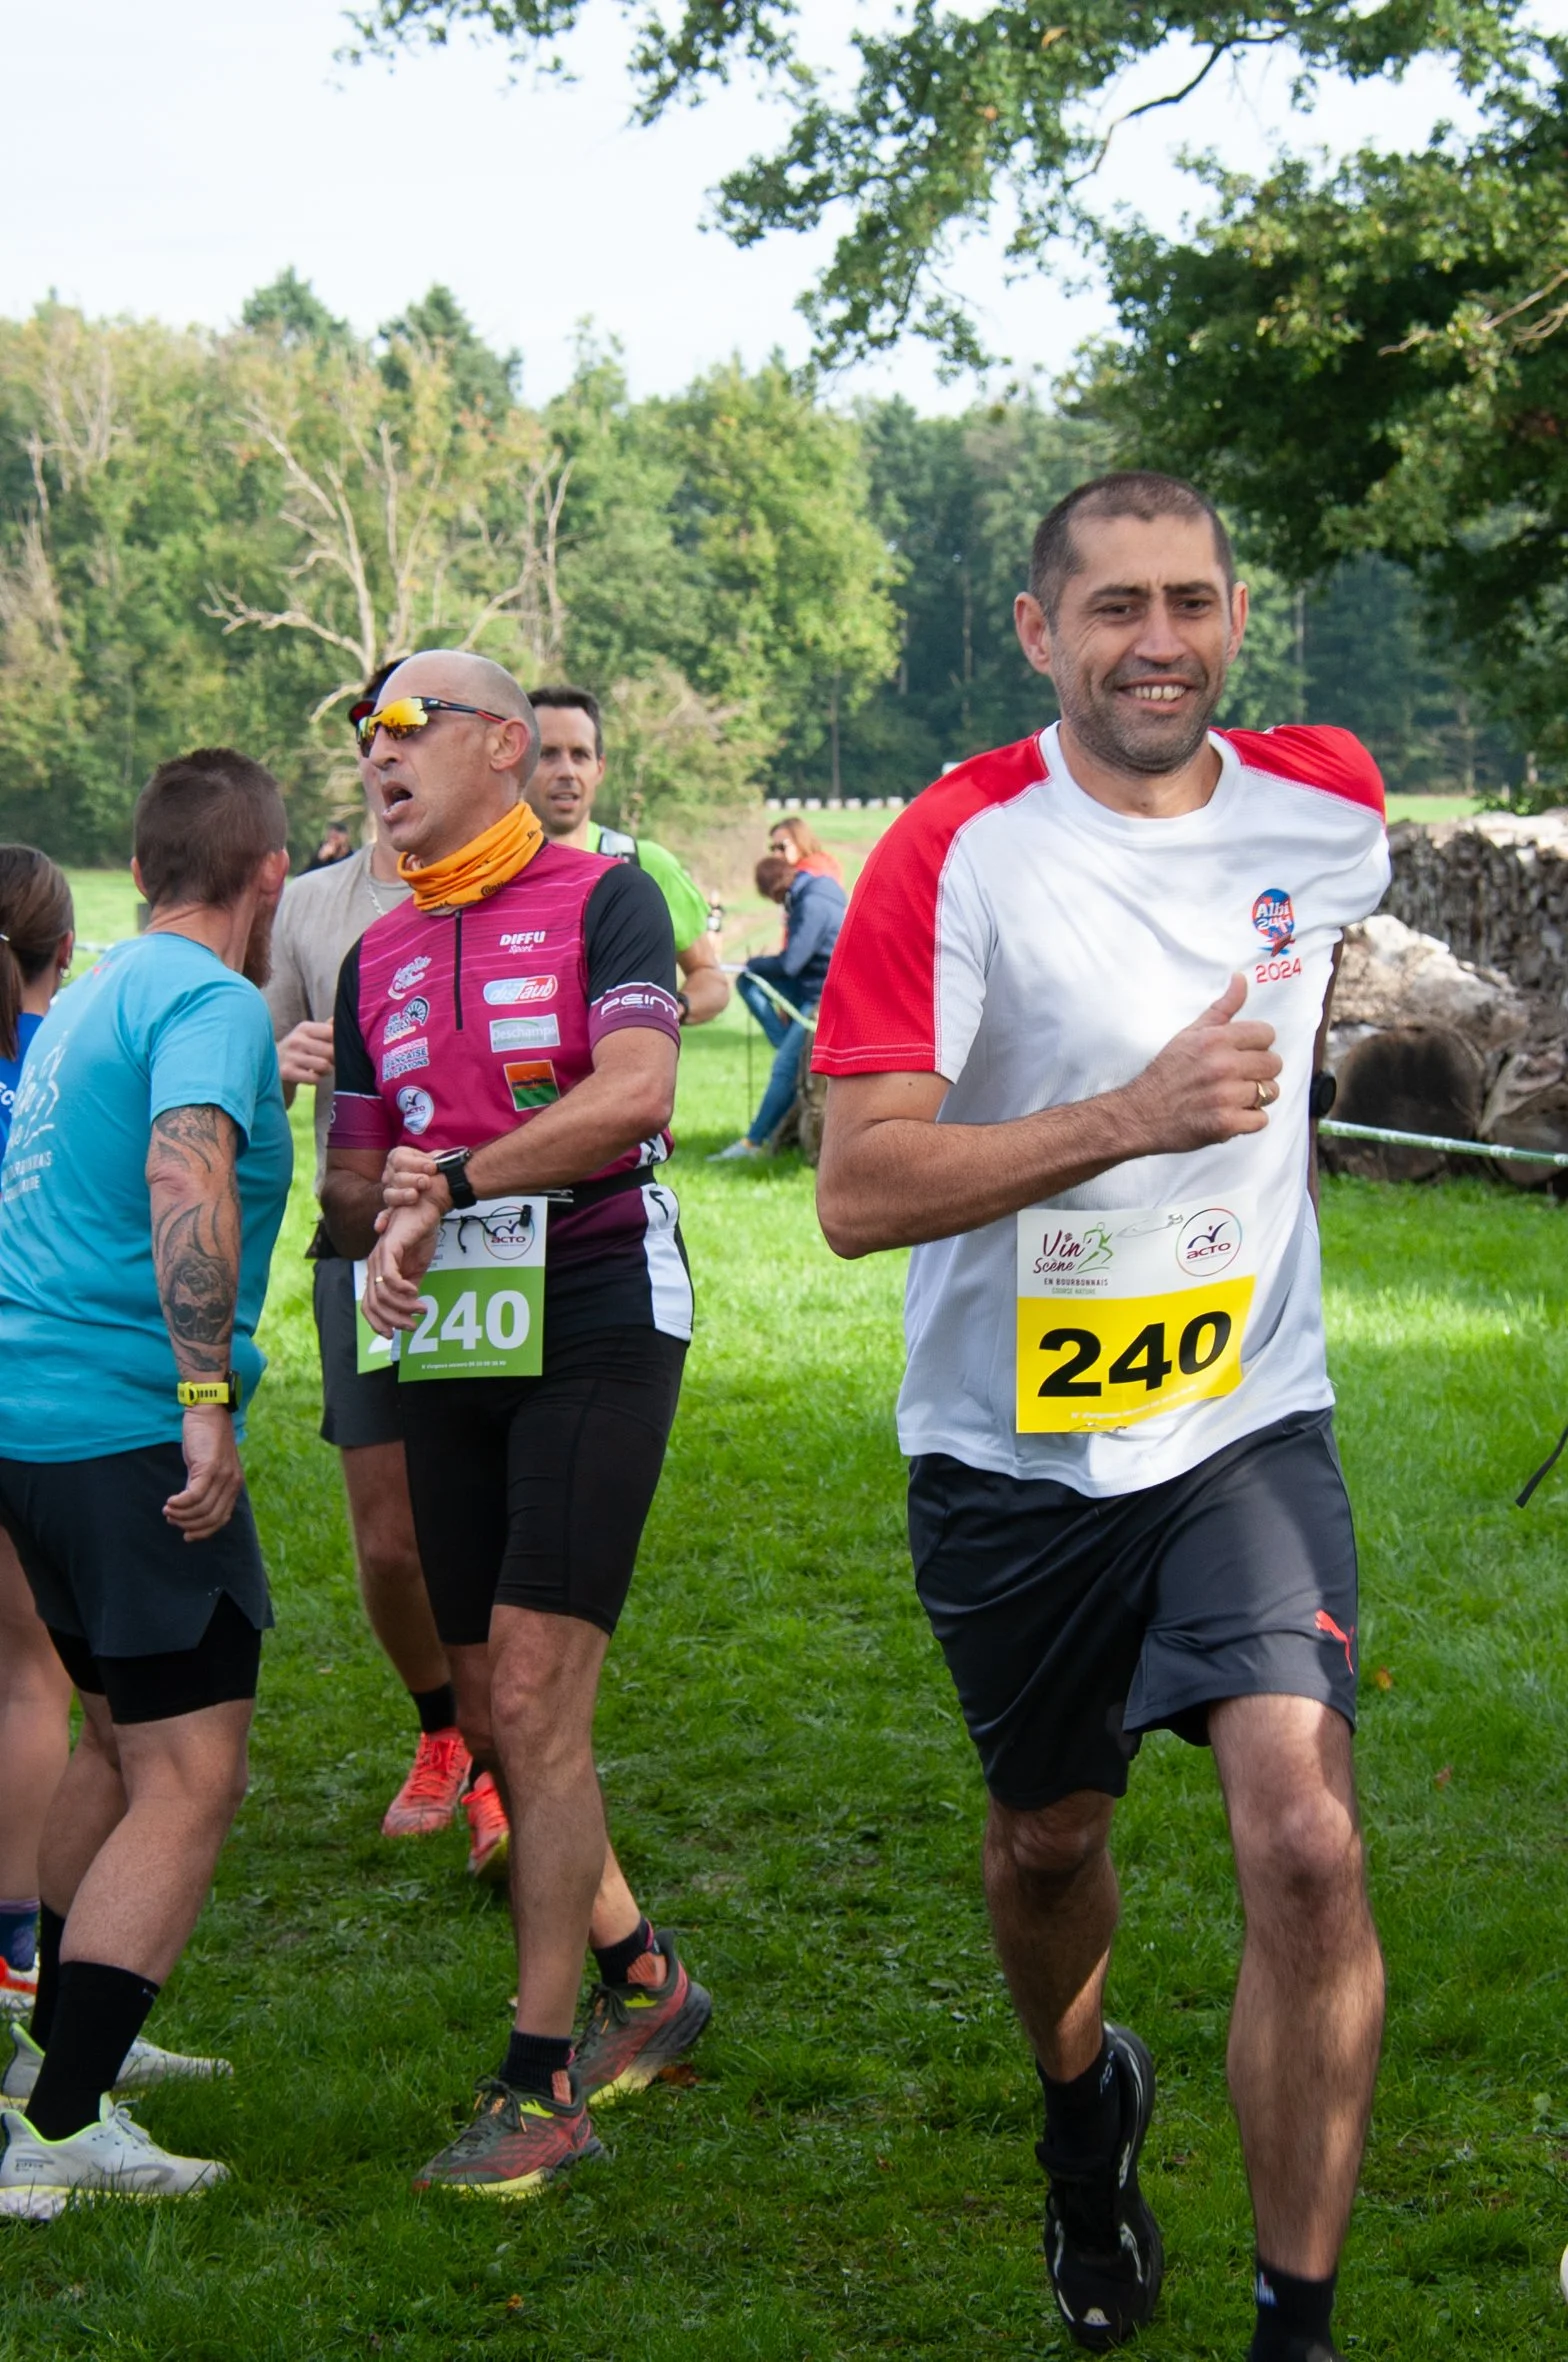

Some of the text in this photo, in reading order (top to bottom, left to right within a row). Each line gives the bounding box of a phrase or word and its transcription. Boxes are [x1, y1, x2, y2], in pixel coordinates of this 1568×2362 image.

[500, 931, 546, 946] DIFFU
[1256, 958, 1300, 983] 2024
[1044, 1278, 1109, 1287] EN BOURBONNAIS
[408, 1289, 530, 1355] 240
[1037, 1310, 1232, 1398] 240
